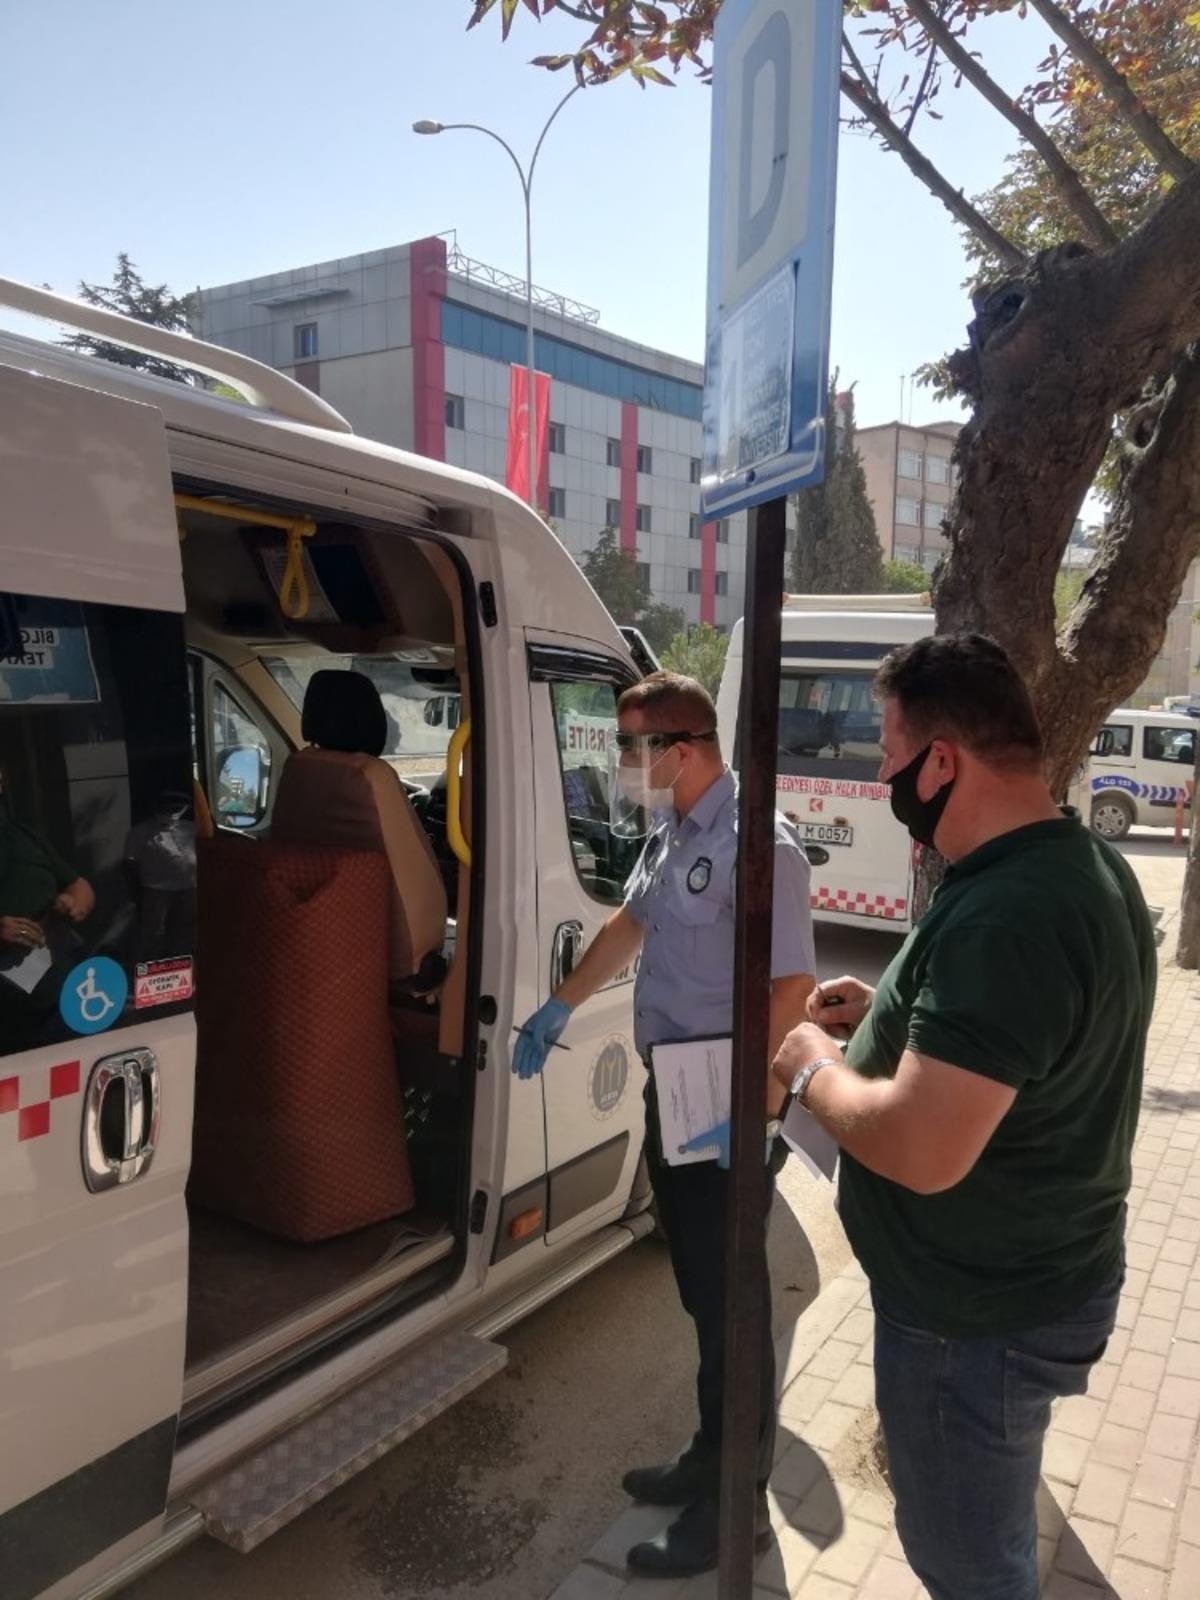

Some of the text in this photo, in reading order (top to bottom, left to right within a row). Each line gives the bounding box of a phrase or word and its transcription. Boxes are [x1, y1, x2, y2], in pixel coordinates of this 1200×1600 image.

[737, 10, 791, 271] D
[805, 825, 814, 837] M
[818, 827, 849, 841] 0057
